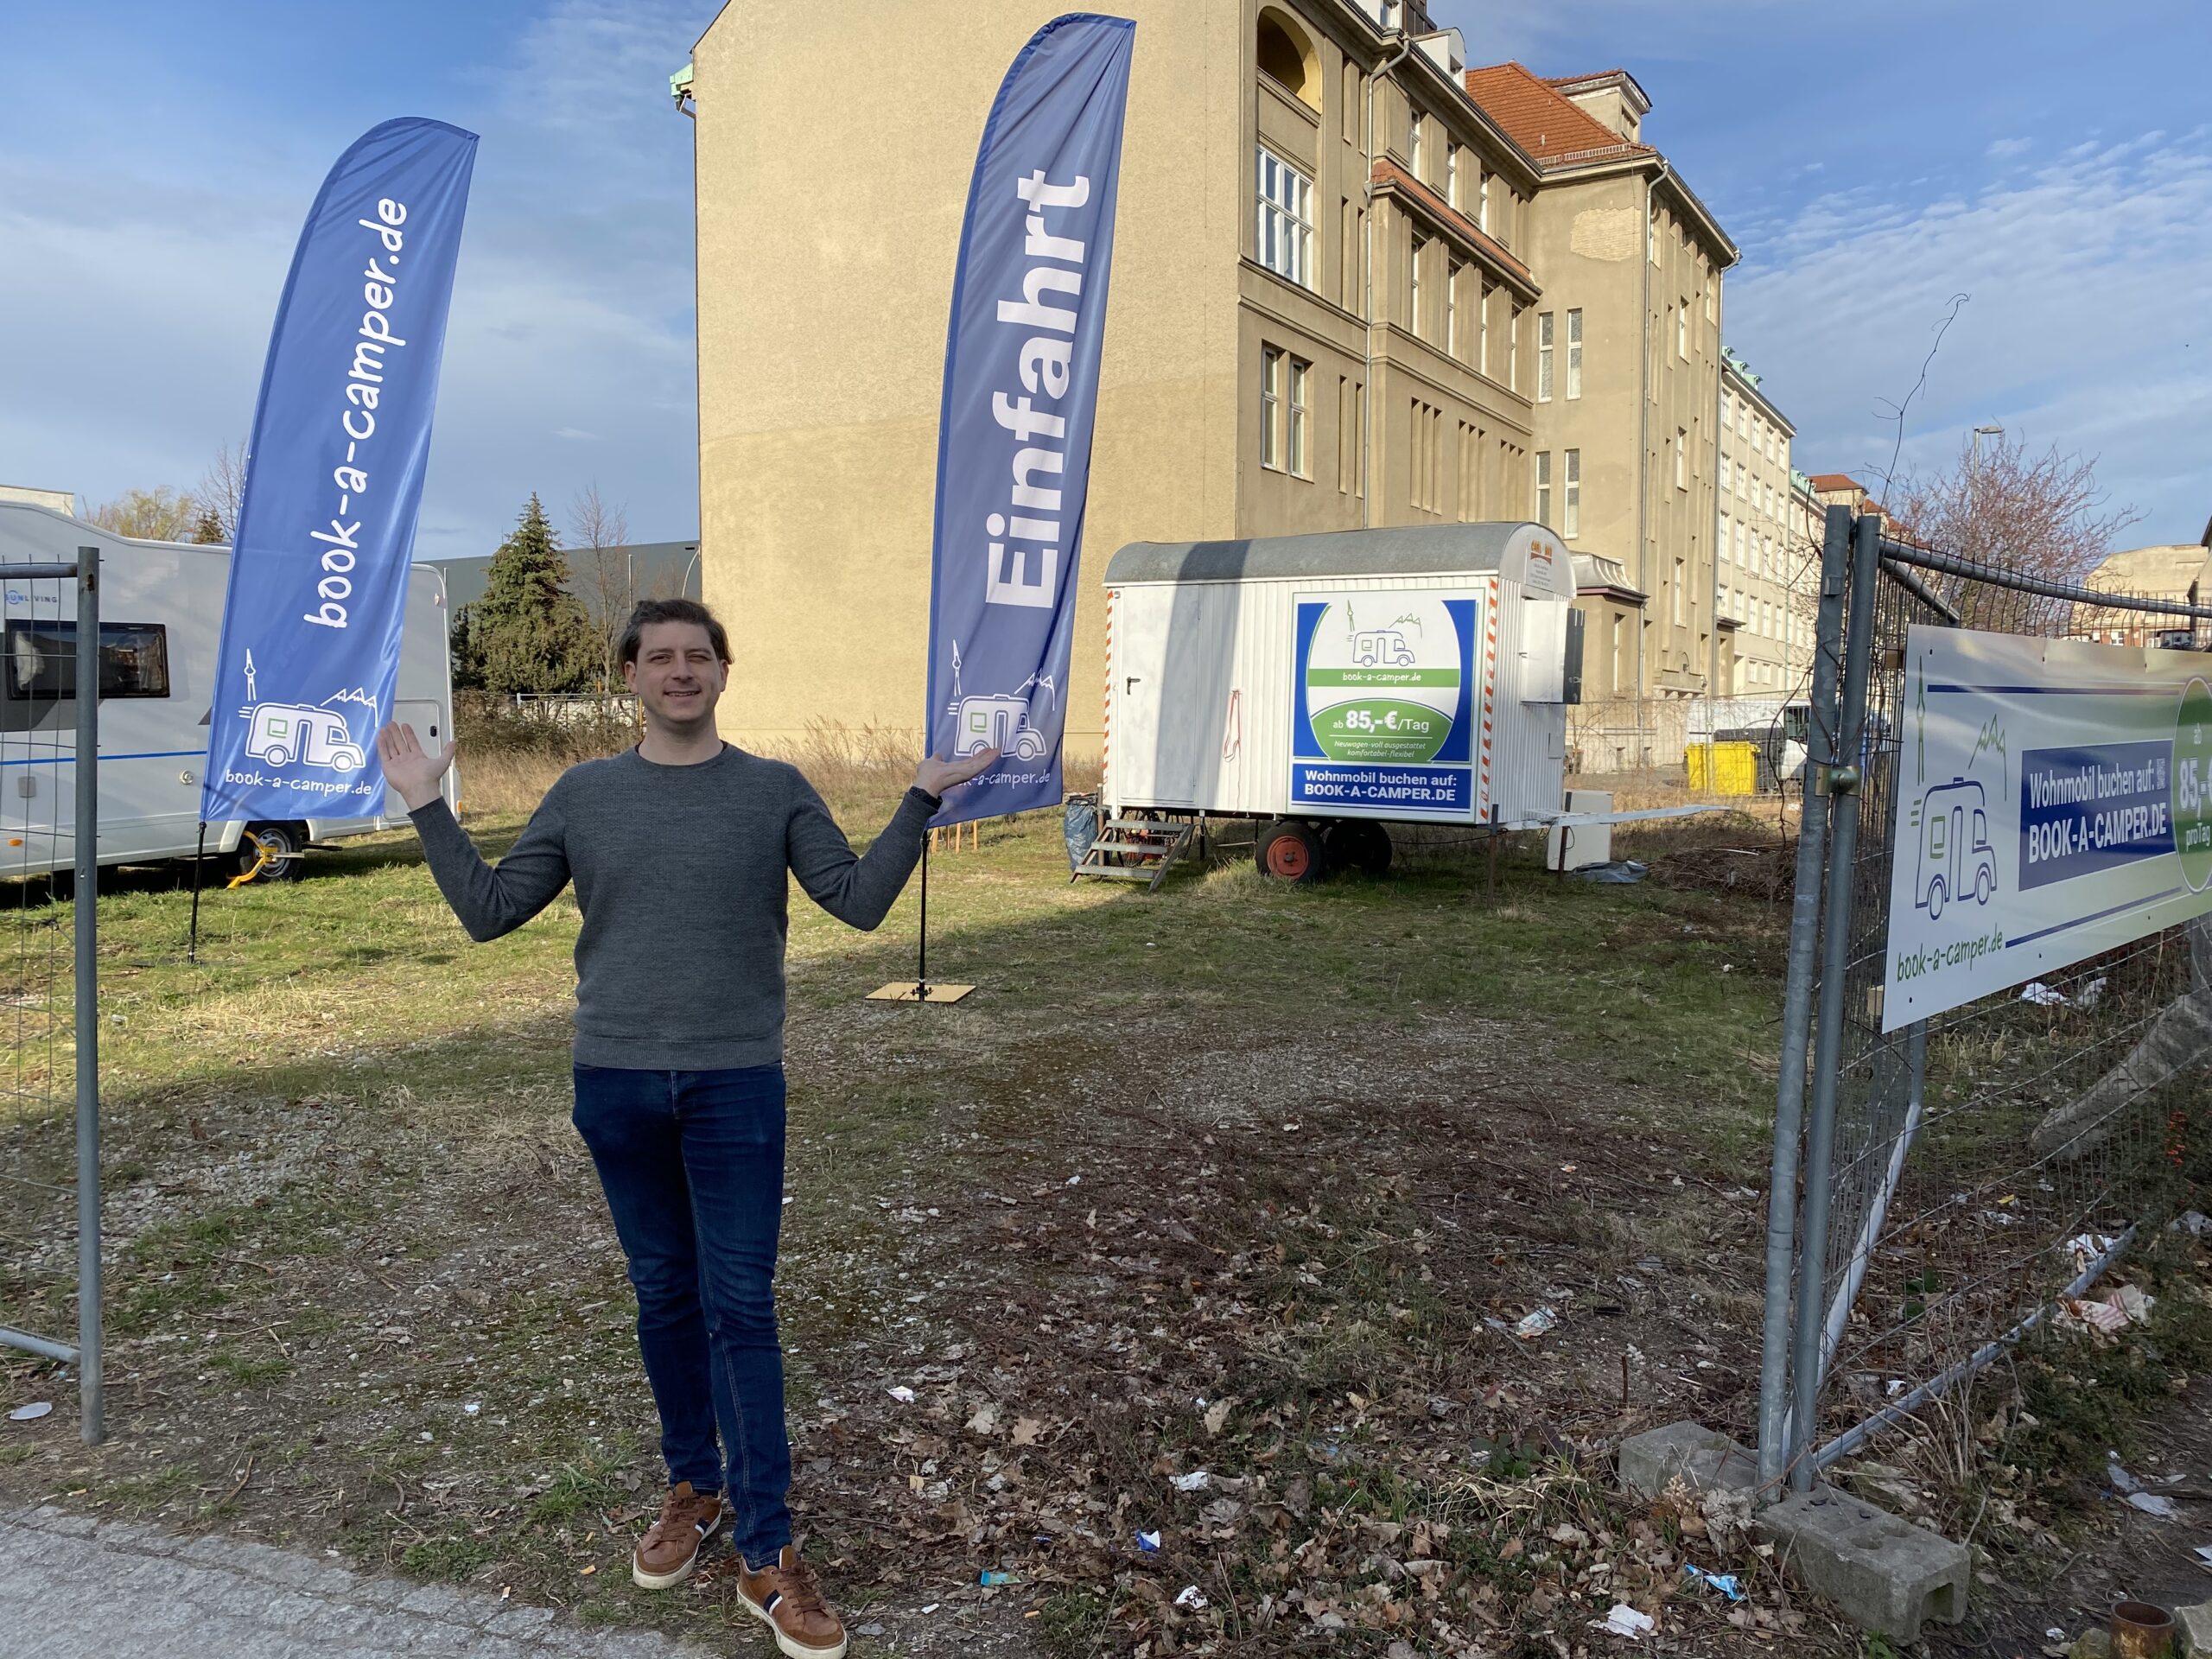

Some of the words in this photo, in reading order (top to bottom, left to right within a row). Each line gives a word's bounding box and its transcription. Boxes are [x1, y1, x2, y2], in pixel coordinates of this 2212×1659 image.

[985, 168, 1090, 609] Einfahrt
[303, 197, 408, 628] book-a-camper.de
[4, 589, 58, 605] SUNLVING
[1342, 671, 1421, 684] book-a-camper.de
[1332, 720, 1344, 728] ab
[2194, 722, 2202, 745] ab
[225, 769, 372, 798] book-a-camper.de
[957, 768, 1051, 790] -a-camper.de
[1305, 770, 1376, 784] Wohnmobil
[1379, 772, 1427, 785] buchen
[1431, 774, 1457, 786] auf:
[2031, 765, 2095, 810] Wohnmobil
[2098, 762, 2135, 799] buchen
[2137, 759, 2155, 793] auf:
[1304, 783, 1456, 801] BOOK-A-CAMPER.DE
[2029, 802, 2167, 864] BOOK-A-CAMPER.DE
[1897, 922, 2003, 983] book-a-camper.de
